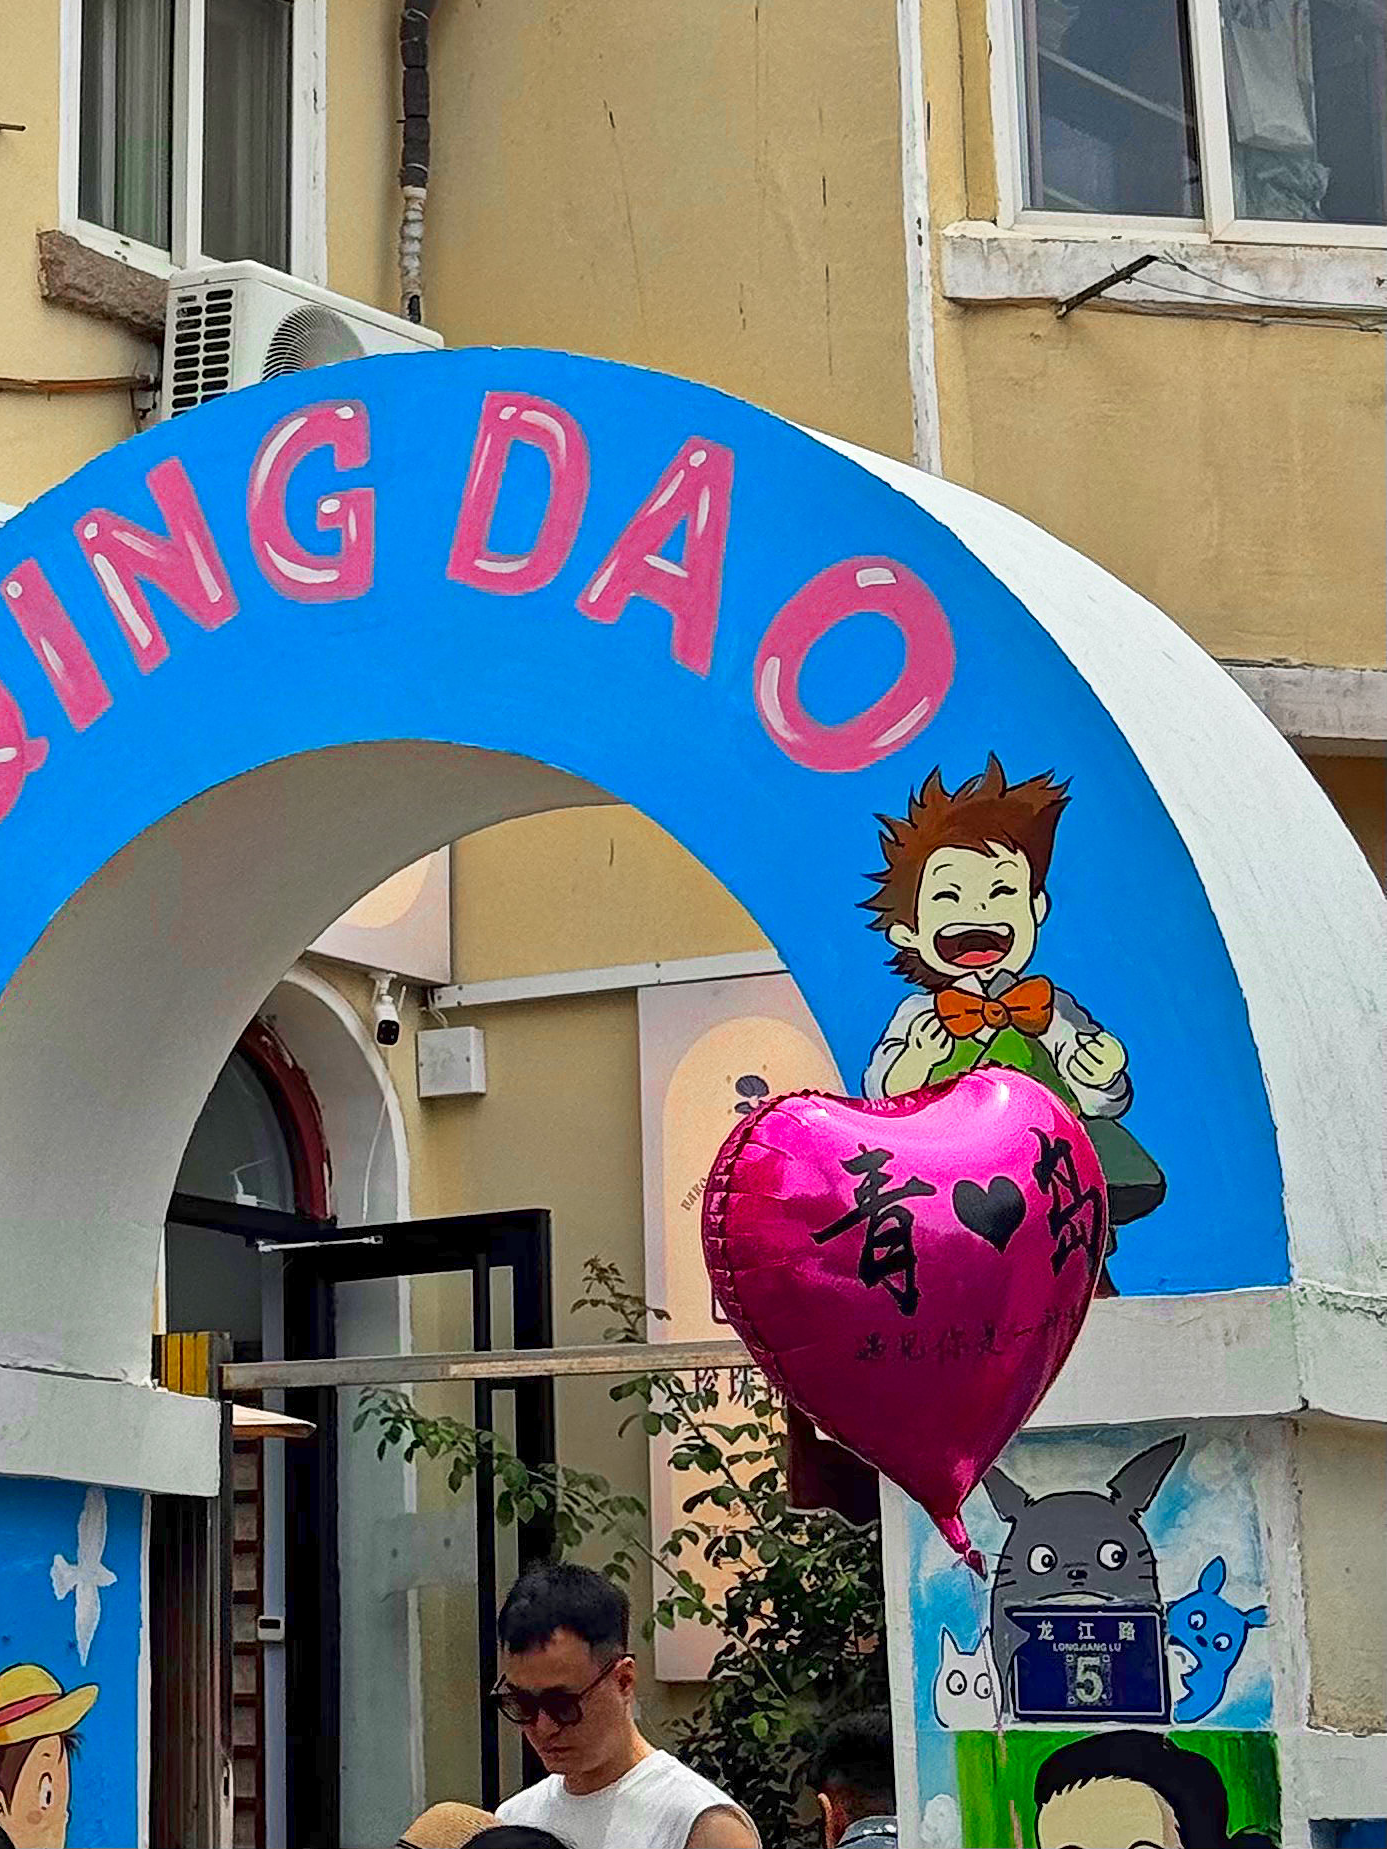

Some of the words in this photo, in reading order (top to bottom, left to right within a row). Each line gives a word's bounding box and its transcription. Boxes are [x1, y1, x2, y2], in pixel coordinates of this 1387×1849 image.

[445, 390, 957, 774] DAO
[1036, 1619, 1136, 1642] 龙江路
[1052, 1642, 1109, 1652] LONGJIANG
[1109, 1642, 1122, 1652] LU
[1075, 1656, 1104, 1703] 5
